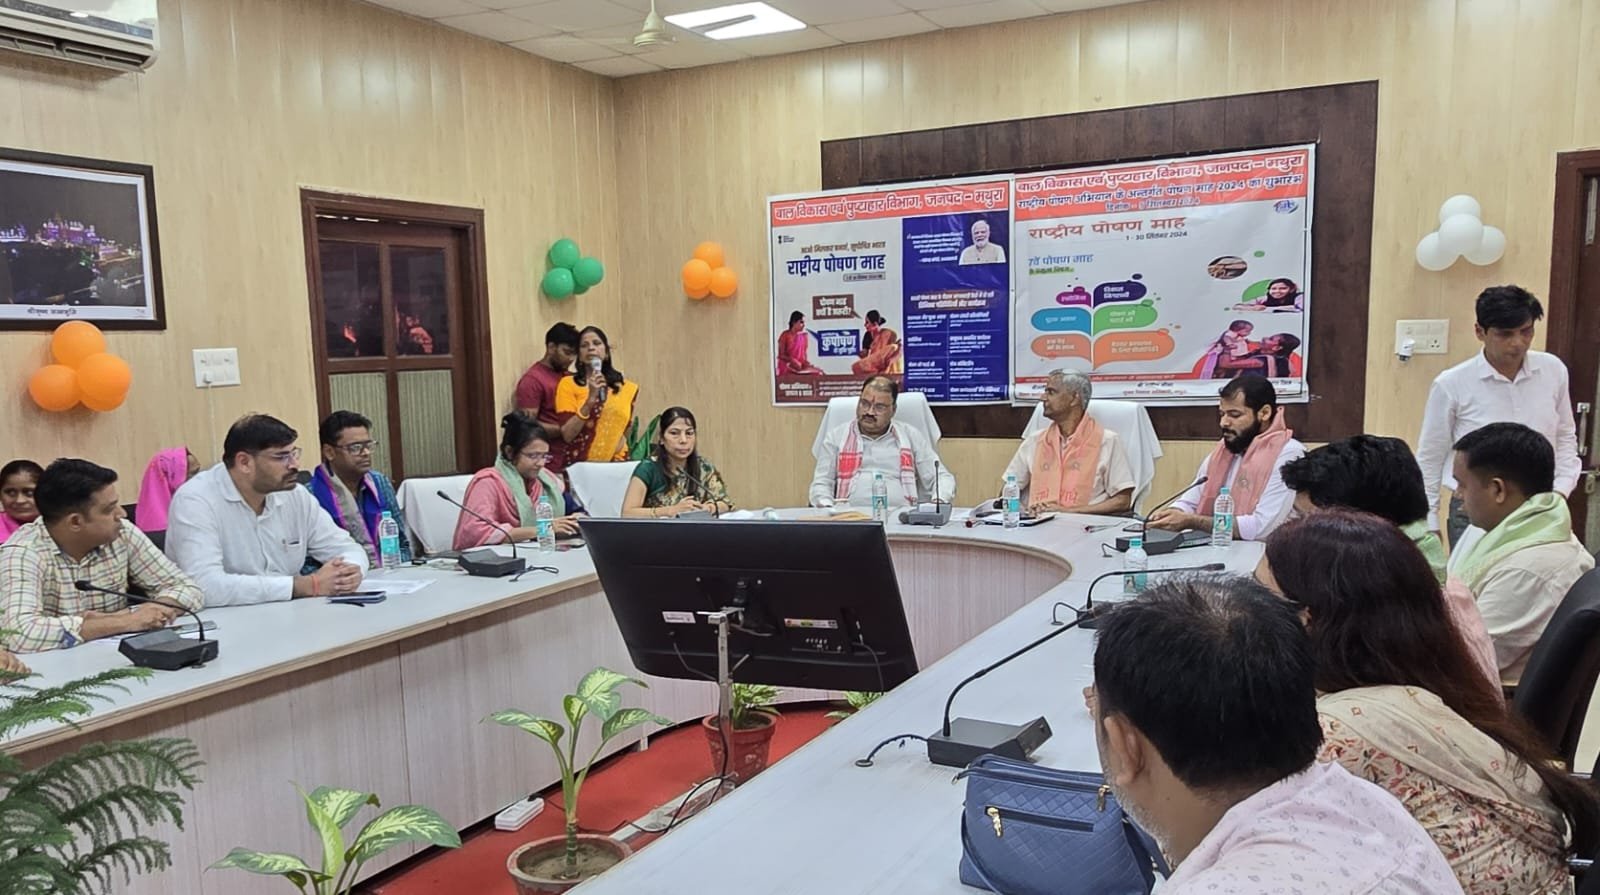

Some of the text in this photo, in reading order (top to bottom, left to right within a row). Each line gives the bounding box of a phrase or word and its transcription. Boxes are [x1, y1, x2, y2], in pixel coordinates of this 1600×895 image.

[1207, 160, 1250, 173] जनपद
[1266, 155, 1303, 172] मथुरा
[830, 199, 846, 215] एवं
[926, 192, 962, 206] जनपद
[976, 189, 1003, 208] मथुरा
[1017, 195, 1045, 209] राष्ट्रीय
[1048, 192, 1072, 206] पोषण
[1075, 190, 1112, 204] अभियान
[1115, 188, 1124, 199] के
[1167, 183, 1192, 195] पोषण
[1196, 181, 1214, 193] माह
[1249, 177, 1261, 188] का
[1028, 216, 1187, 240] राष्ट्रीय पोषण माह
[786, 253, 886, 277] राष्ट्रीय पोषण माह
[1042, 255, 1070, 266] पोषण
[1073, 253, 1094, 264] माह
